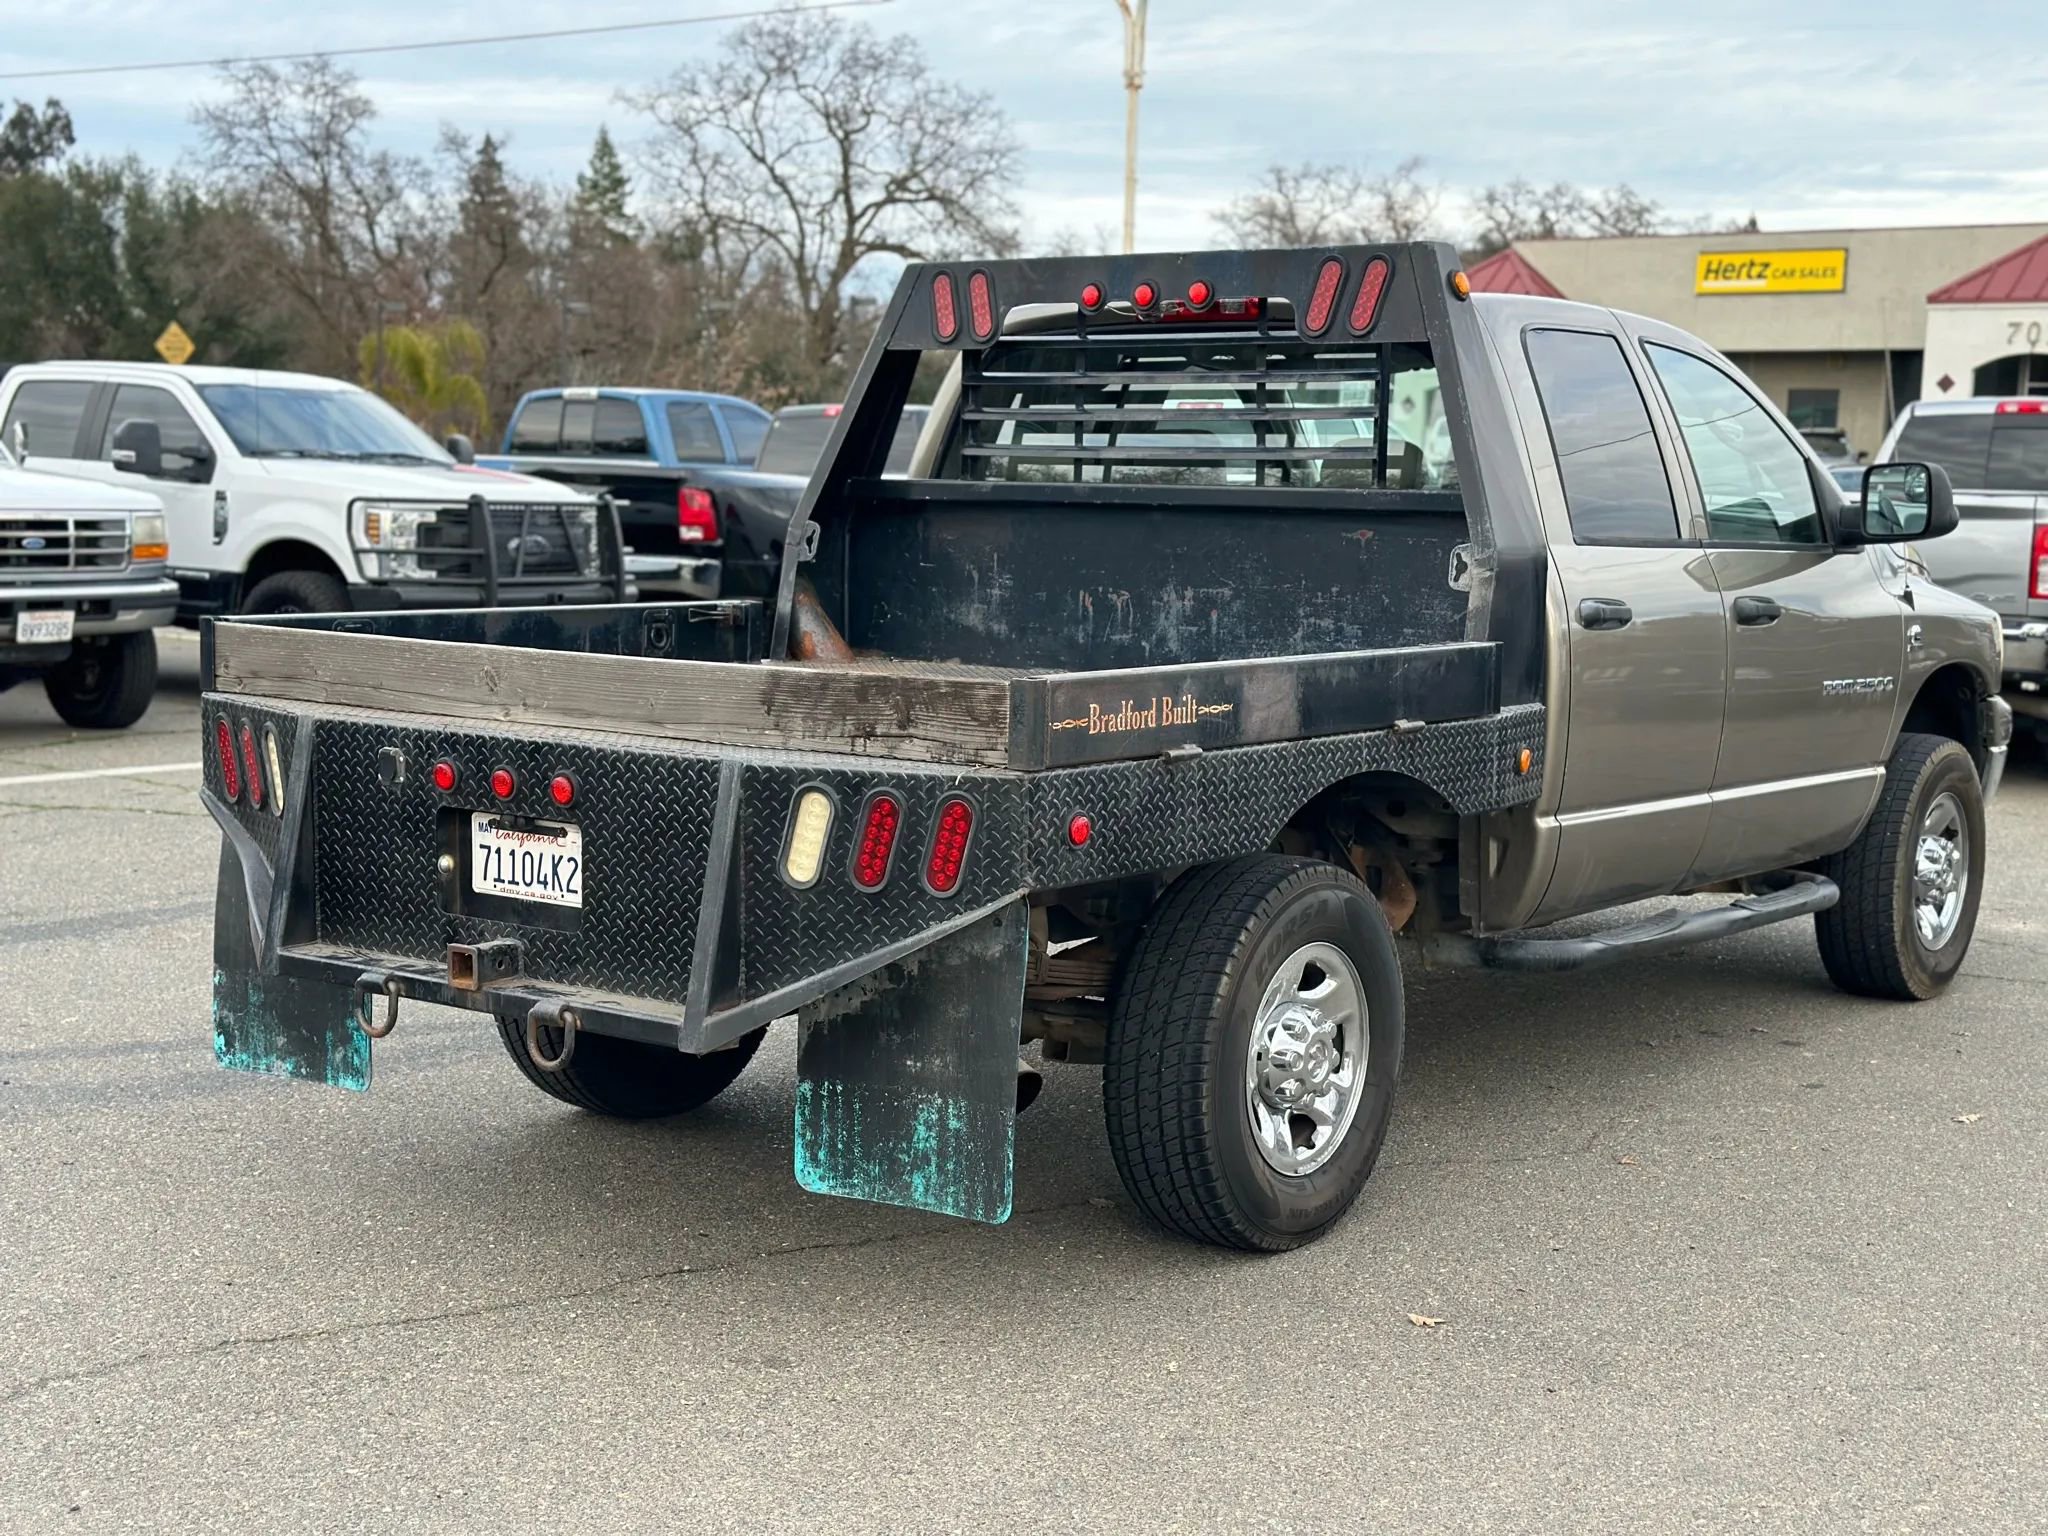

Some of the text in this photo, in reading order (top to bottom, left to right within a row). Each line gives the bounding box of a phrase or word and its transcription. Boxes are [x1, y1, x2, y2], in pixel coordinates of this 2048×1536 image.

[1704, 258, 1838, 281] Hertz CAR SALES
[2006, 321, 2048, 345] 70
[1089, 693, 1198, 734] Bradford Built
[479, 843, 578, 894] 71104K2
[499, 886, 559, 900] dmv.ca.gov
